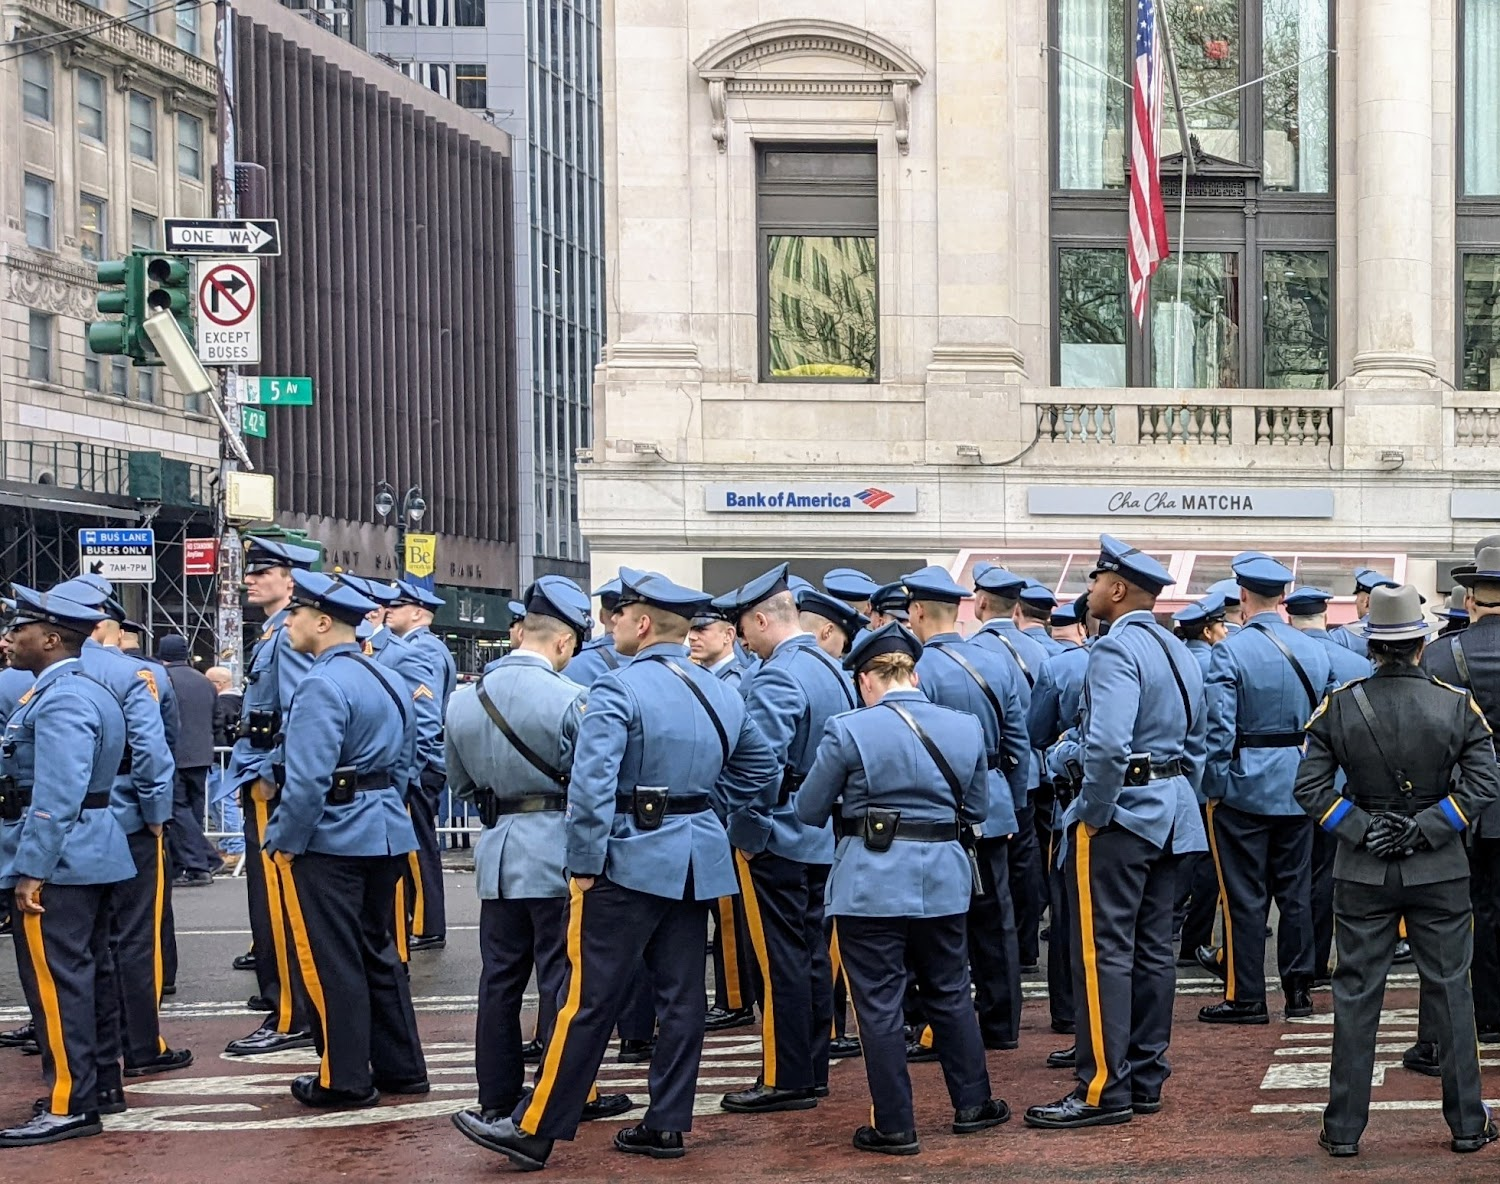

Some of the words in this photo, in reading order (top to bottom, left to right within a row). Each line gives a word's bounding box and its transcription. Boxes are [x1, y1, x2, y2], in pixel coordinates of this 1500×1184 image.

[182, 229, 214, 243] ONE
[229, 231, 261, 244] WAY
[205, 331, 251, 344] EXCEPT
[208, 346, 248, 359] BUSES
[271, 381, 280, 401] 5
[243, 410, 247, 430] E
[248, 412, 258, 432] 42
[726, 491, 767, 507] Bank
[768, 491, 784, 507] of
[786, 491, 851, 508] America
[1108, 491, 1141, 512] Cha
[1144, 491, 1177, 512] Cha
[1182, 495, 1254, 511] MATCHA
[100, 532, 120, 542] BUS
[122, 533, 148, 542] LANE
[86, 546, 120, 555] BUSES
[122, 546, 147, 555] ONLY
[409, 546, 431, 564] Be
[110, 564, 147, 572] 7AM-7PM
